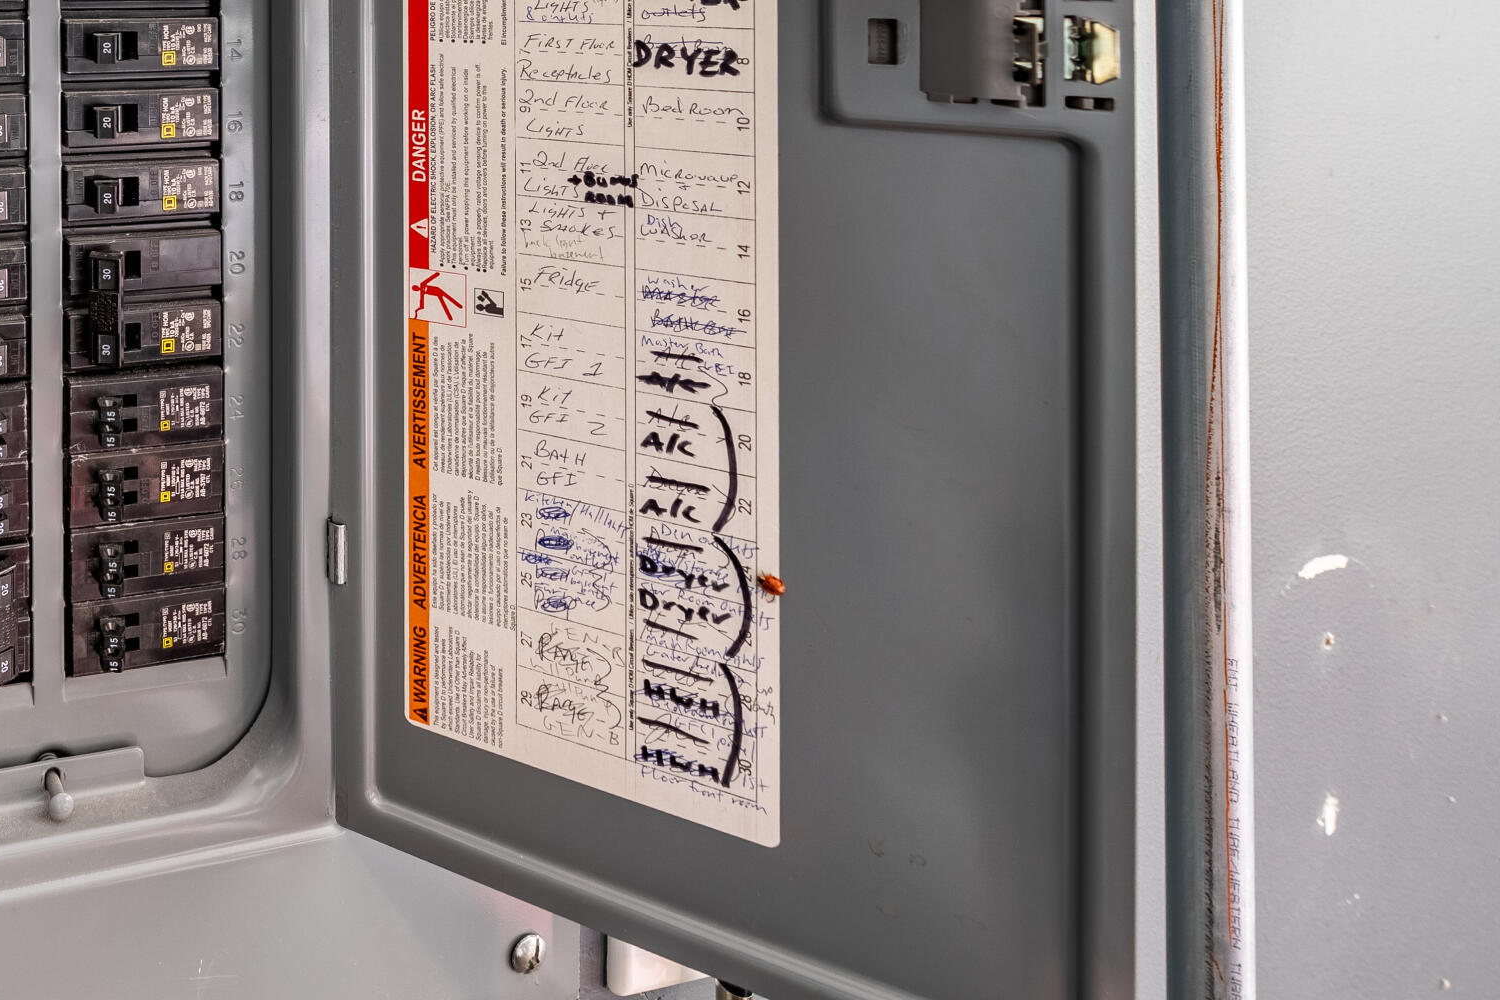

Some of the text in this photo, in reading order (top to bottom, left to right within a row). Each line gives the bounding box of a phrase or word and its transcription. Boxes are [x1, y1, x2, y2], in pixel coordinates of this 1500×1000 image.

[103, 42, 112, 54] 20
[632, 39, 740, 78] DRYER
[737, 57, 750, 65] 8
[520, 88, 556, 107] 2nd
[642, 95, 682, 116] Bed
[103, 116, 112, 128] 20
[226, 111, 243, 135] 16
[737, 117, 750, 132] 10
[412, 108, 426, 182] DANGER
[520, 161, 531, 174] 11
[228, 180, 244, 203] 18
[738, 180, 750, 194] 12
[104, 192, 112, 204] 20
[520, 218, 532, 232] 13
[738, 244, 751, 260] 14
[228, 250, 246, 275] 20
[103, 268, 111, 280] 30
[520, 278, 532, 291] 15
[738, 309, 751, 324] 16
[520, 336, 532, 348] 17
[525, 352, 572, 370] GFI
[738, 372, 752, 386] 18
[412, 332, 426, 470] AVERTISSEMENT
[521, 394, 532, 408] 19
[529, 410, 608, 436] GFI 2
[641, 432, 695, 457] A/C
[738, 435, 752, 451] 20
[521, 455, 532, 470] 21
[536, 471, 578, 487] GFI
[640, 499, 701, 523] A/C
[738, 499, 752, 515] 22
[521, 513, 532, 528] 23
[413, 494, 427, 610] ADVERTENCIA
[109, 562, 117, 573] 15
[521, 572, 532, 588] 25
[2, 584, 9, 596] 20
[521, 632, 532, 648] 27
[110, 662, 118, 672] 15
[413, 626, 428, 702] WARNING
[521, 690, 532, 707] 29
